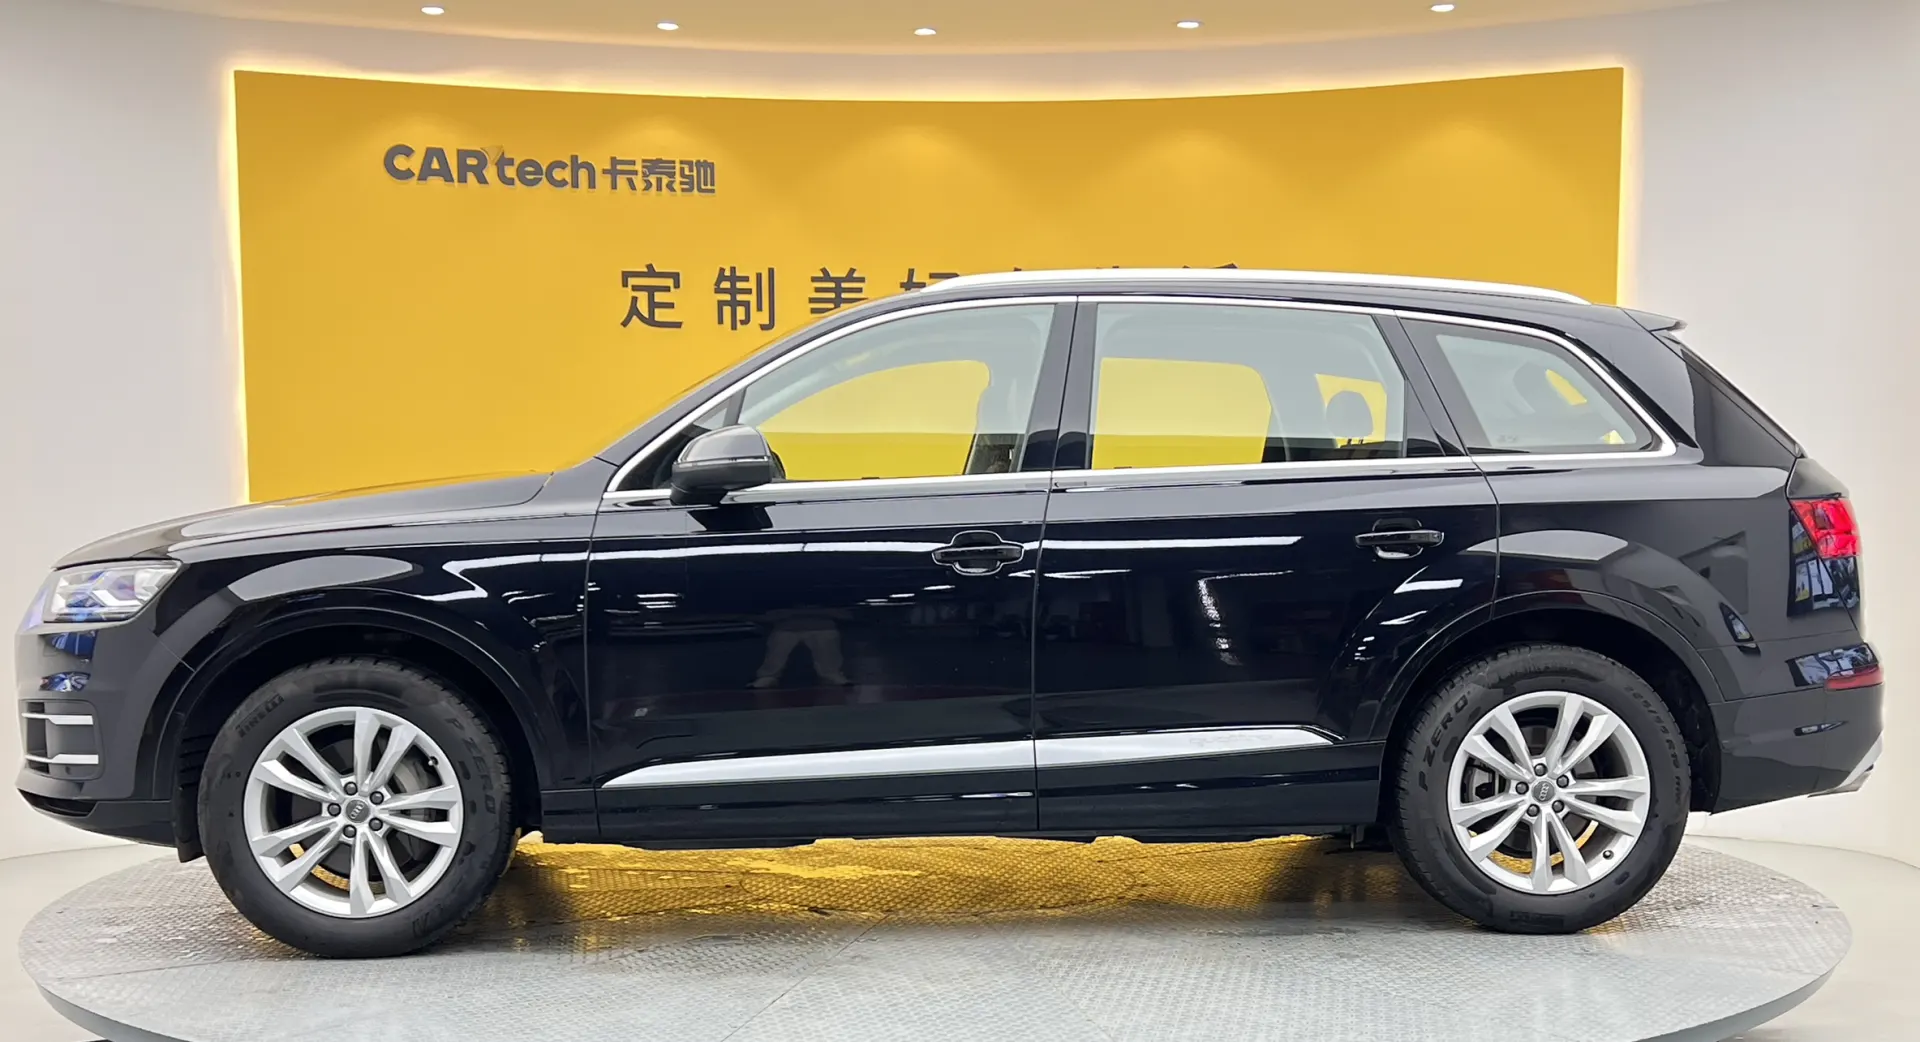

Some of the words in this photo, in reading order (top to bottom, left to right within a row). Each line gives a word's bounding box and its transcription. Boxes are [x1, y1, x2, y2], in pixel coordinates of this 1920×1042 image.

[383, 143, 597, 190] CARtech
[602, 155, 716, 194] 卡泰驰
